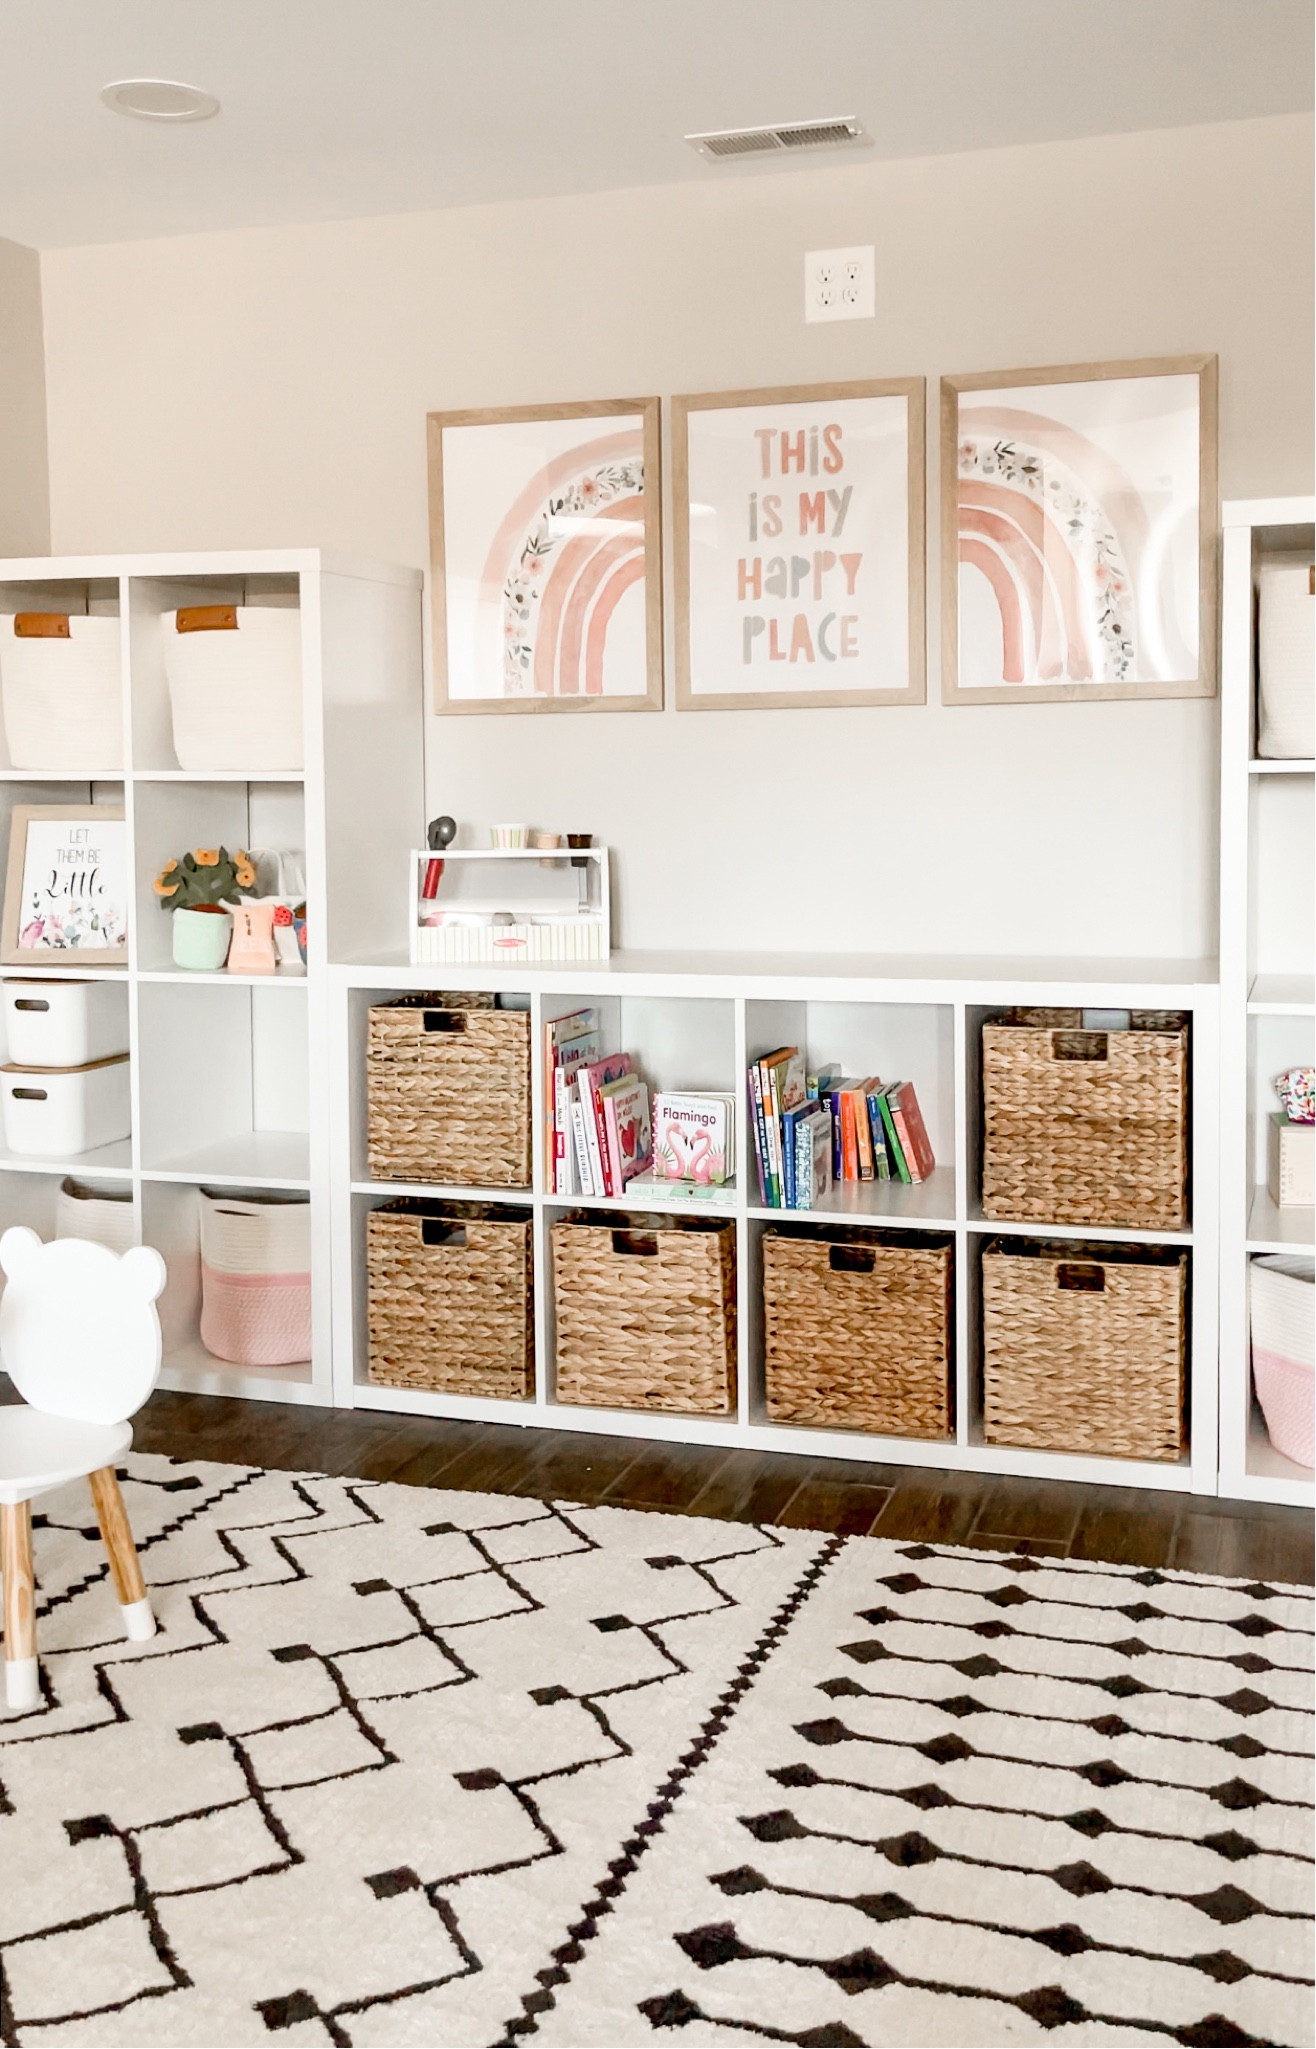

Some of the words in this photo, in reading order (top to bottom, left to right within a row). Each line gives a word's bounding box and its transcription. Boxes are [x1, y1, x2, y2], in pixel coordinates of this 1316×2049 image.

[800, 486, 853, 537] MY
[743, 612, 859, 664] PLACE
[69, 829, 90, 843] LET
[57, 849, 84, 864] THEM
[88, 849, 101, 864] BE
[45, 868, 106, 898] Little
[663, 1107, 716, 1127] Flamingo
